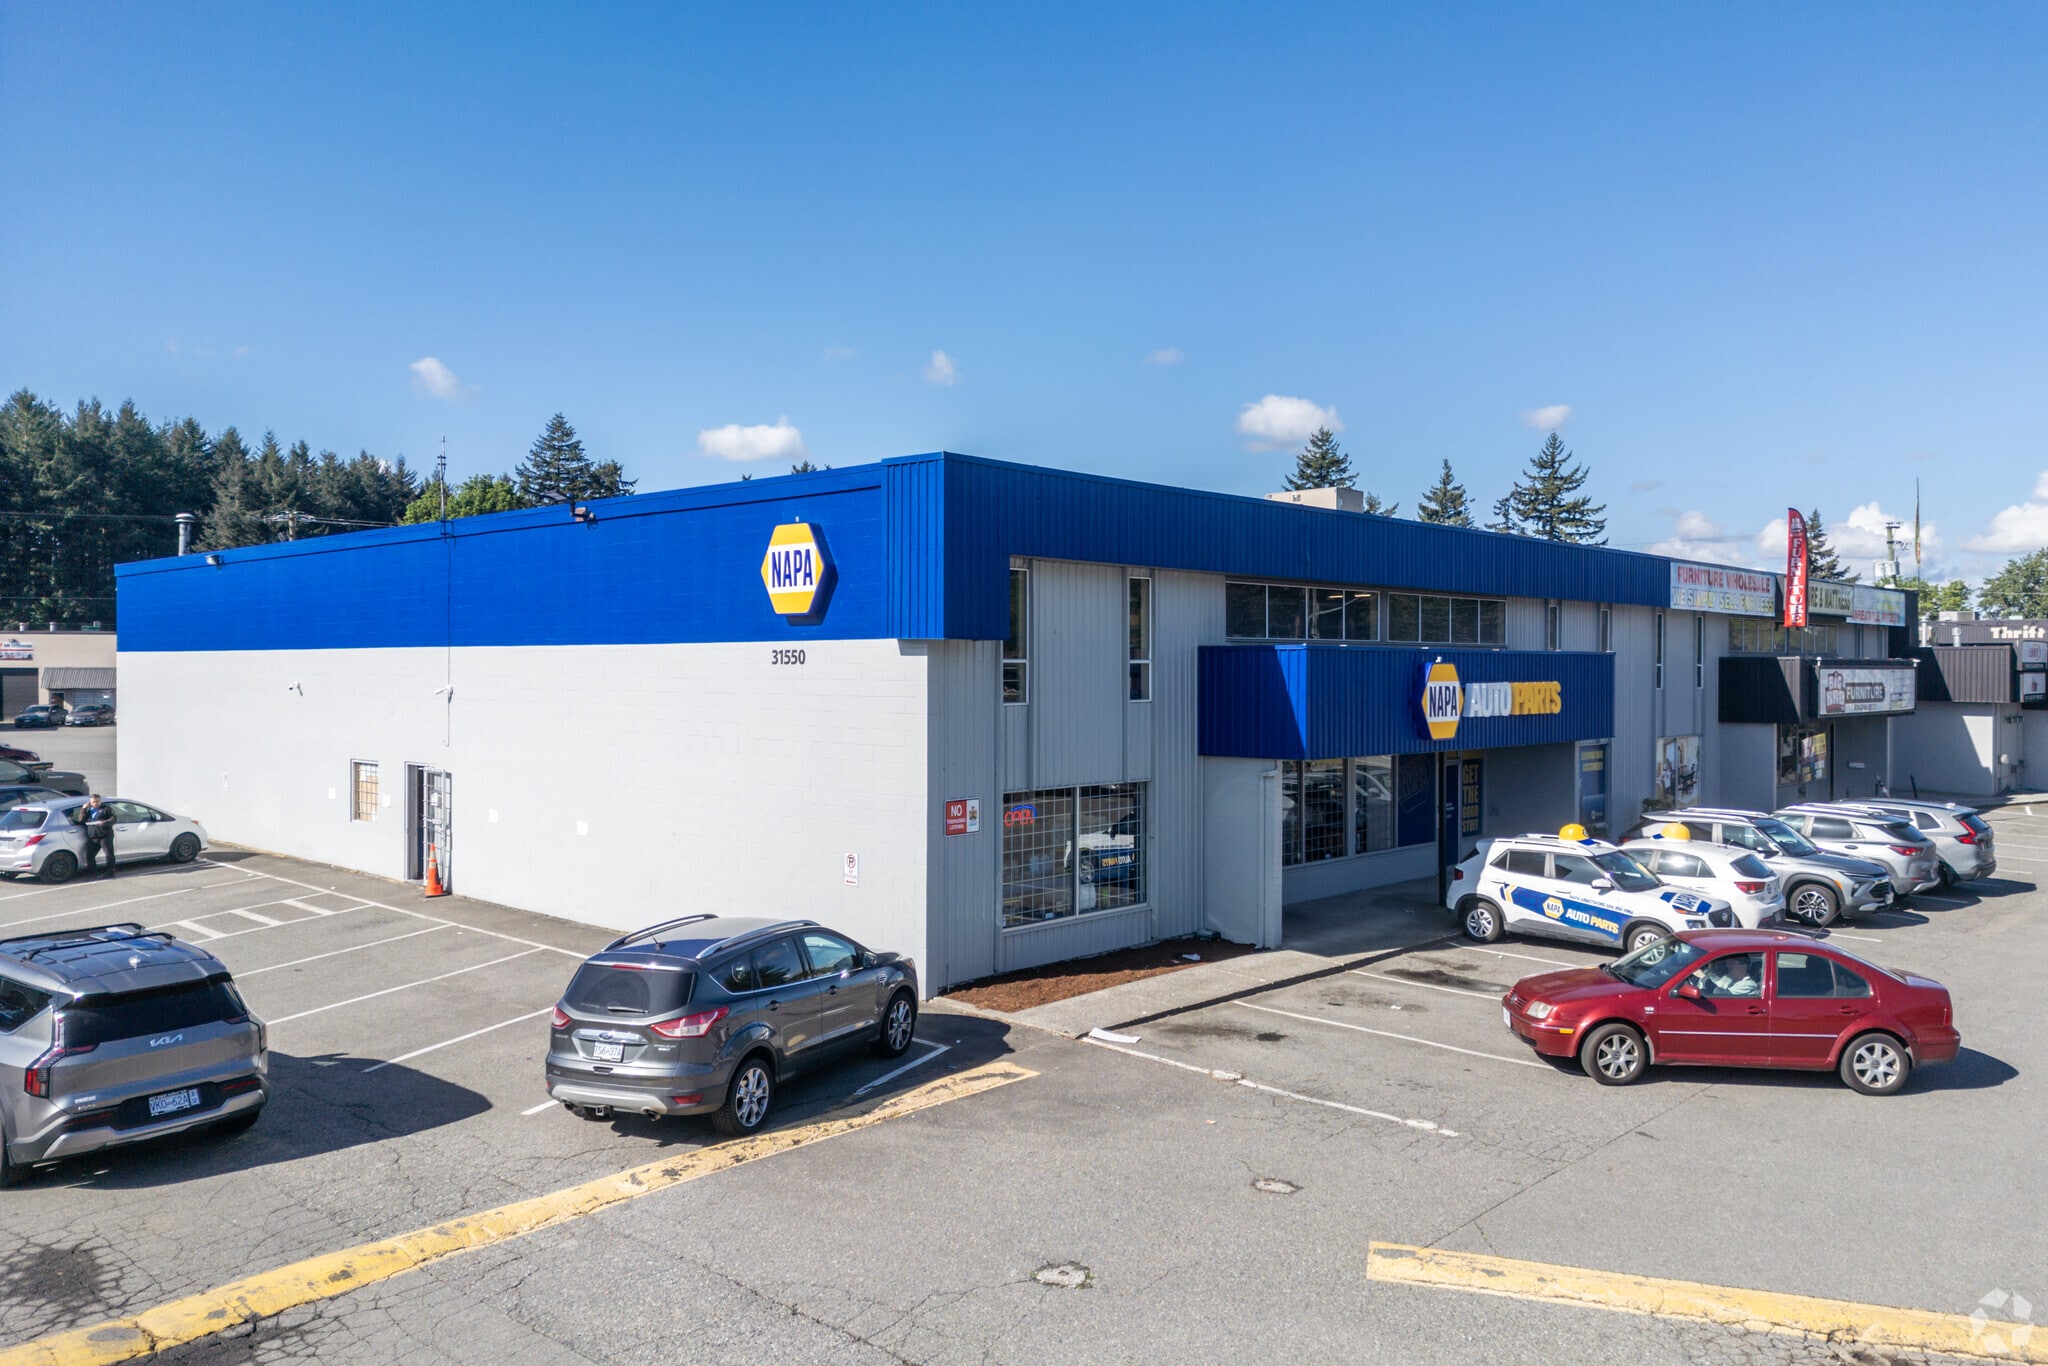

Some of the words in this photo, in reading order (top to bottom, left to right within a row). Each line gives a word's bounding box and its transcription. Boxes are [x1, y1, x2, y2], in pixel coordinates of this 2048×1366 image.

[771, 548, 814, 588] NAPA
[1677, 565, 1724, 588] FURNITURE
[1726, 571, 1771, 593] WHOLESALE
[1789, 538, 1803, 624] FURNITURE
[1990, 625, 2045, 639] Thrift
[771, 649, 806, 665] 31550
[1429, 685, 1458, 718] NAPA
[1464, 682, 1512, 717] AUTO
[1510, 681, 1561, 715] PARTS
[1846, 686, 1884, 700] FURNITURE
[1463, 764, 1479, 784] GET
[1463, 784, 1479, 804] THE
[951, 805, 963, 817] NO
[1462, 805, 1479, 818] GOOD
[1462, 819, 1479, 833] STUFF
[1546, 902, 1561, 914] NAPA
[1566, 909, 1589, 925] AUTO
[1590, 916, 1619, 934] PARTS
